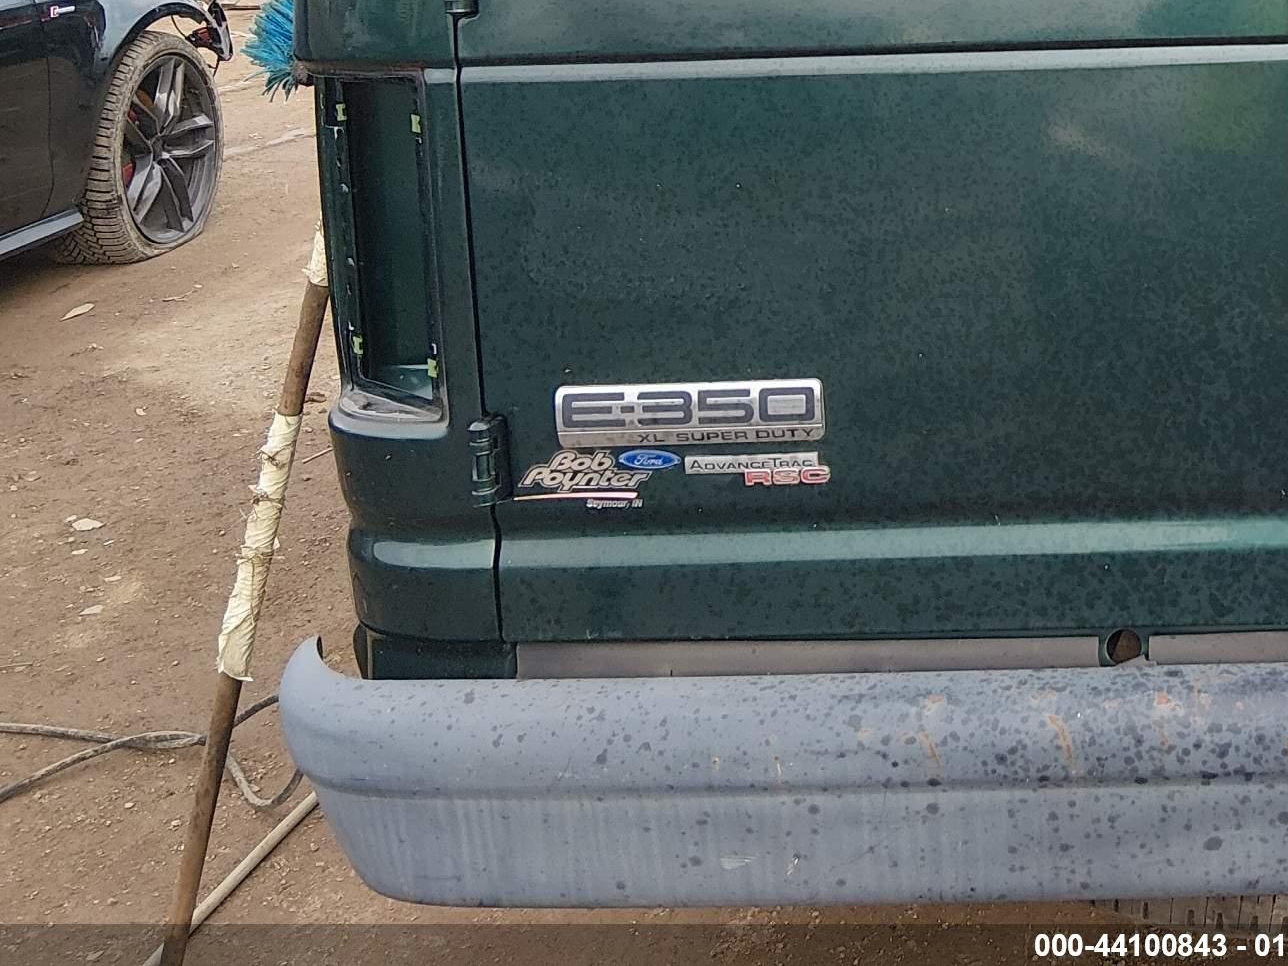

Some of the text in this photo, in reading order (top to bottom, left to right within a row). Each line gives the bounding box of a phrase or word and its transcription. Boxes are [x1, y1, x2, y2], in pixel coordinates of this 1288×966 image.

[561, 386, 816, 429] E-350
[638, 427, 815, 444] XL SUPER DUTY
[551, 451, 613, 472] Bob
[633, 454, 664, 466] Ford
[522, 466, 650, 492] Poynter
[744, 465, 831, 486] RSC
